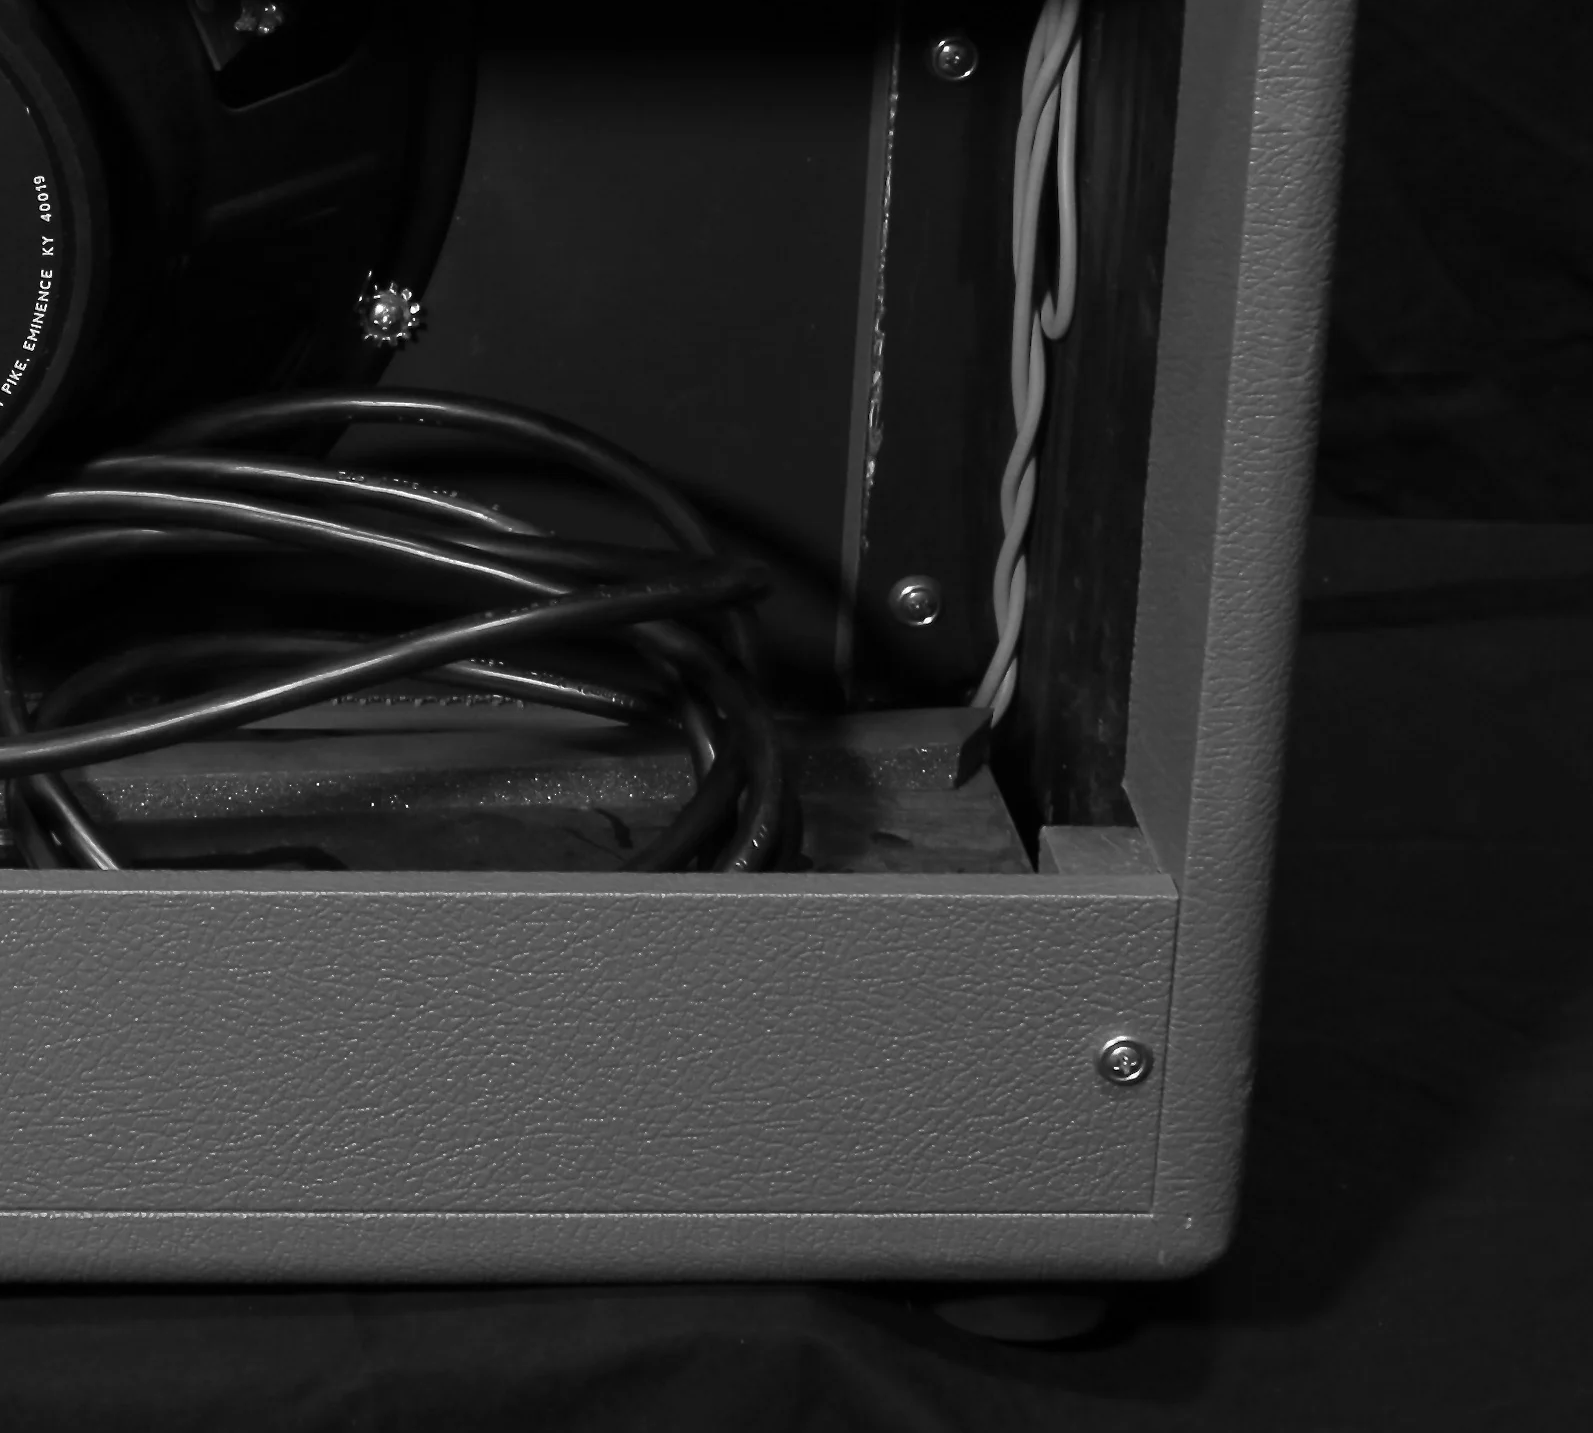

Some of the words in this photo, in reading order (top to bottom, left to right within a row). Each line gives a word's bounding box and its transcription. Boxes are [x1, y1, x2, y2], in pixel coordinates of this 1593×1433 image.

[33, 175, 52, 223] 40019
[41, 235, 55, 256] KY
[22, 269, 53, 352] EMINENCE
